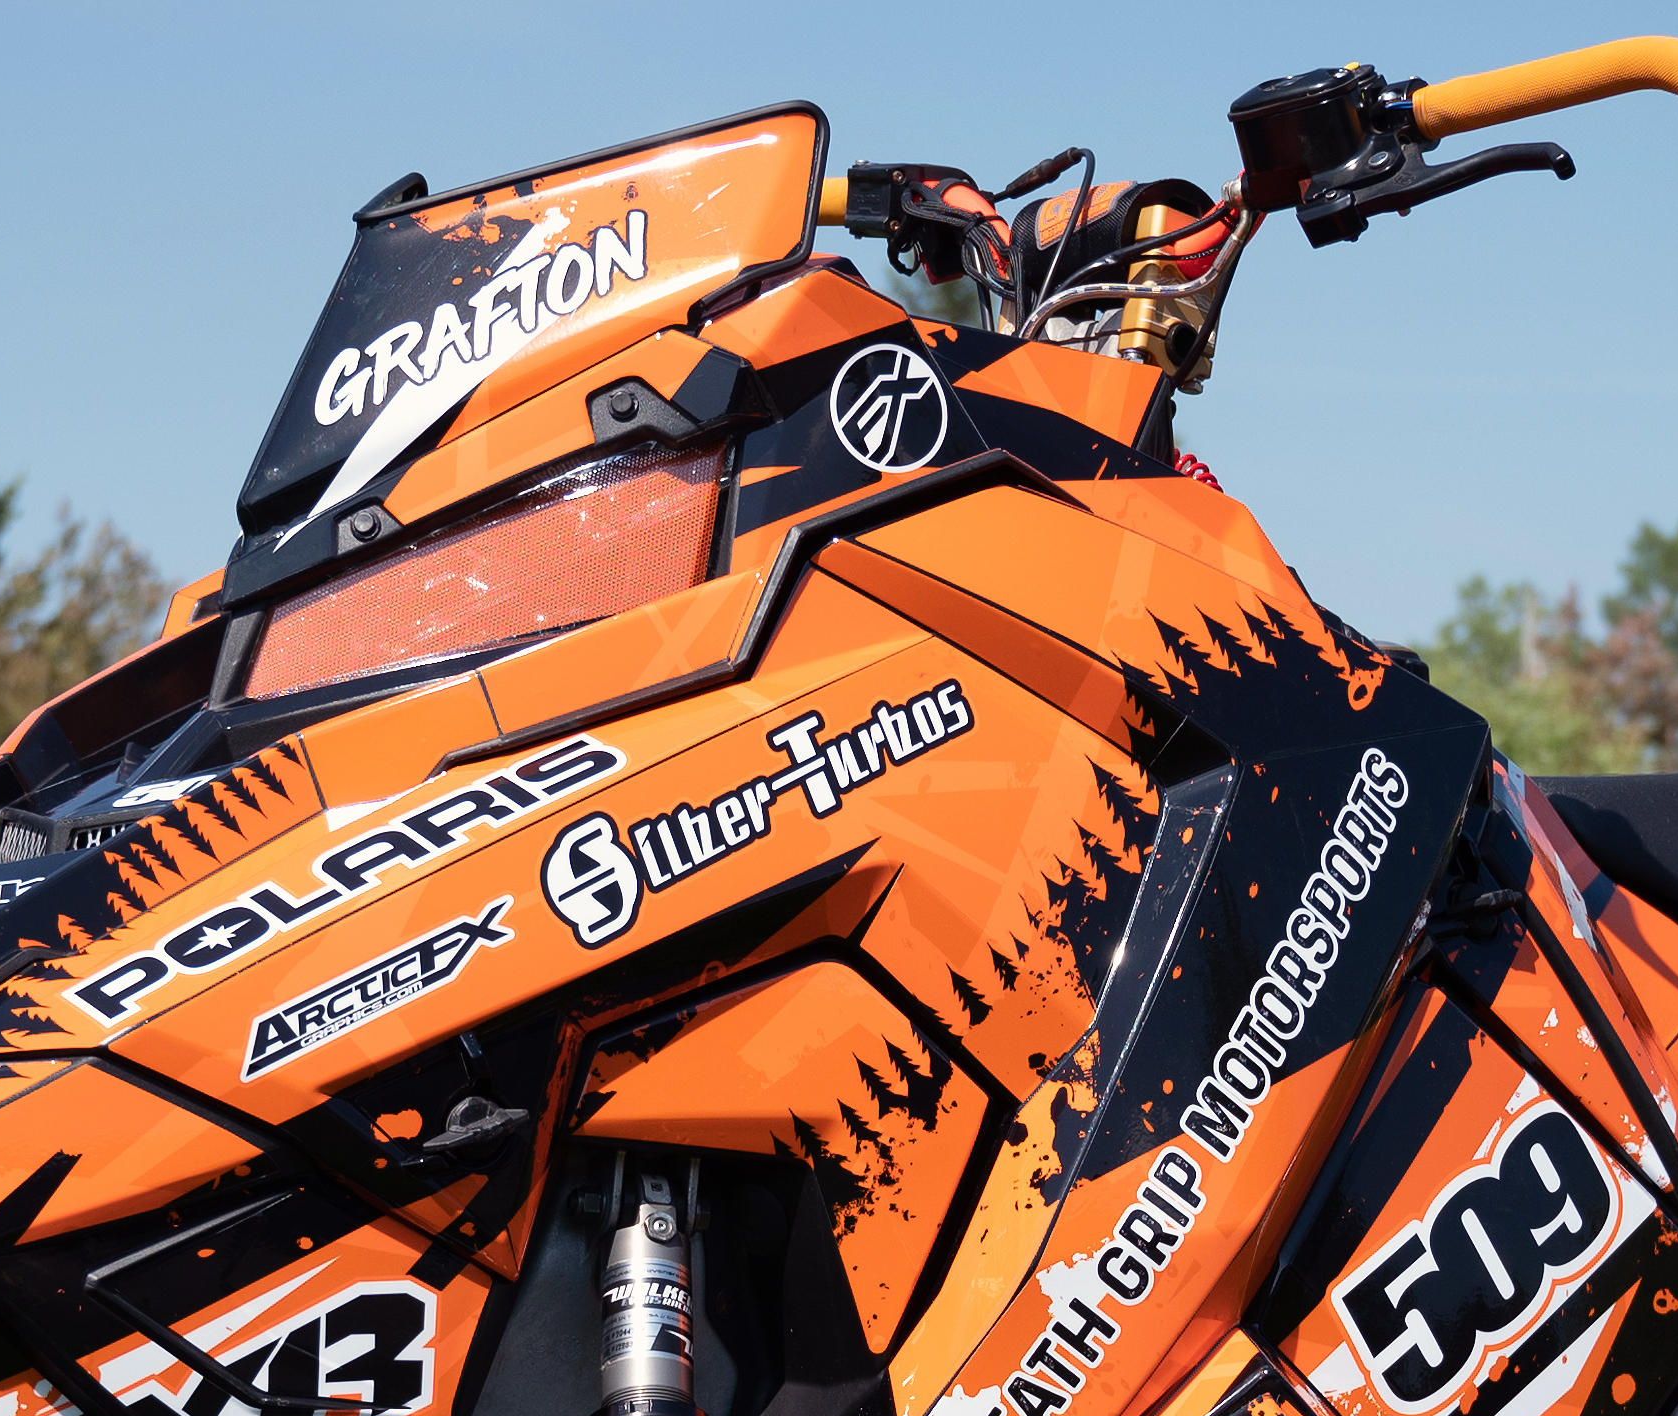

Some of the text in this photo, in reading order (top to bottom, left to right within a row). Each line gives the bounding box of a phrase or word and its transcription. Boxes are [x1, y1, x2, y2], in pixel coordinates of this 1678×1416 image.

[314, 211, 646, 425] GRAFTON
[73, 740, 624, 1024] POLARIS
[1097, 1148, 1203, 1306] GRIP
[1181, 748, 1410, 1163] MOTORSPORTS
[1341, 1110, 1610, 1404] 509
